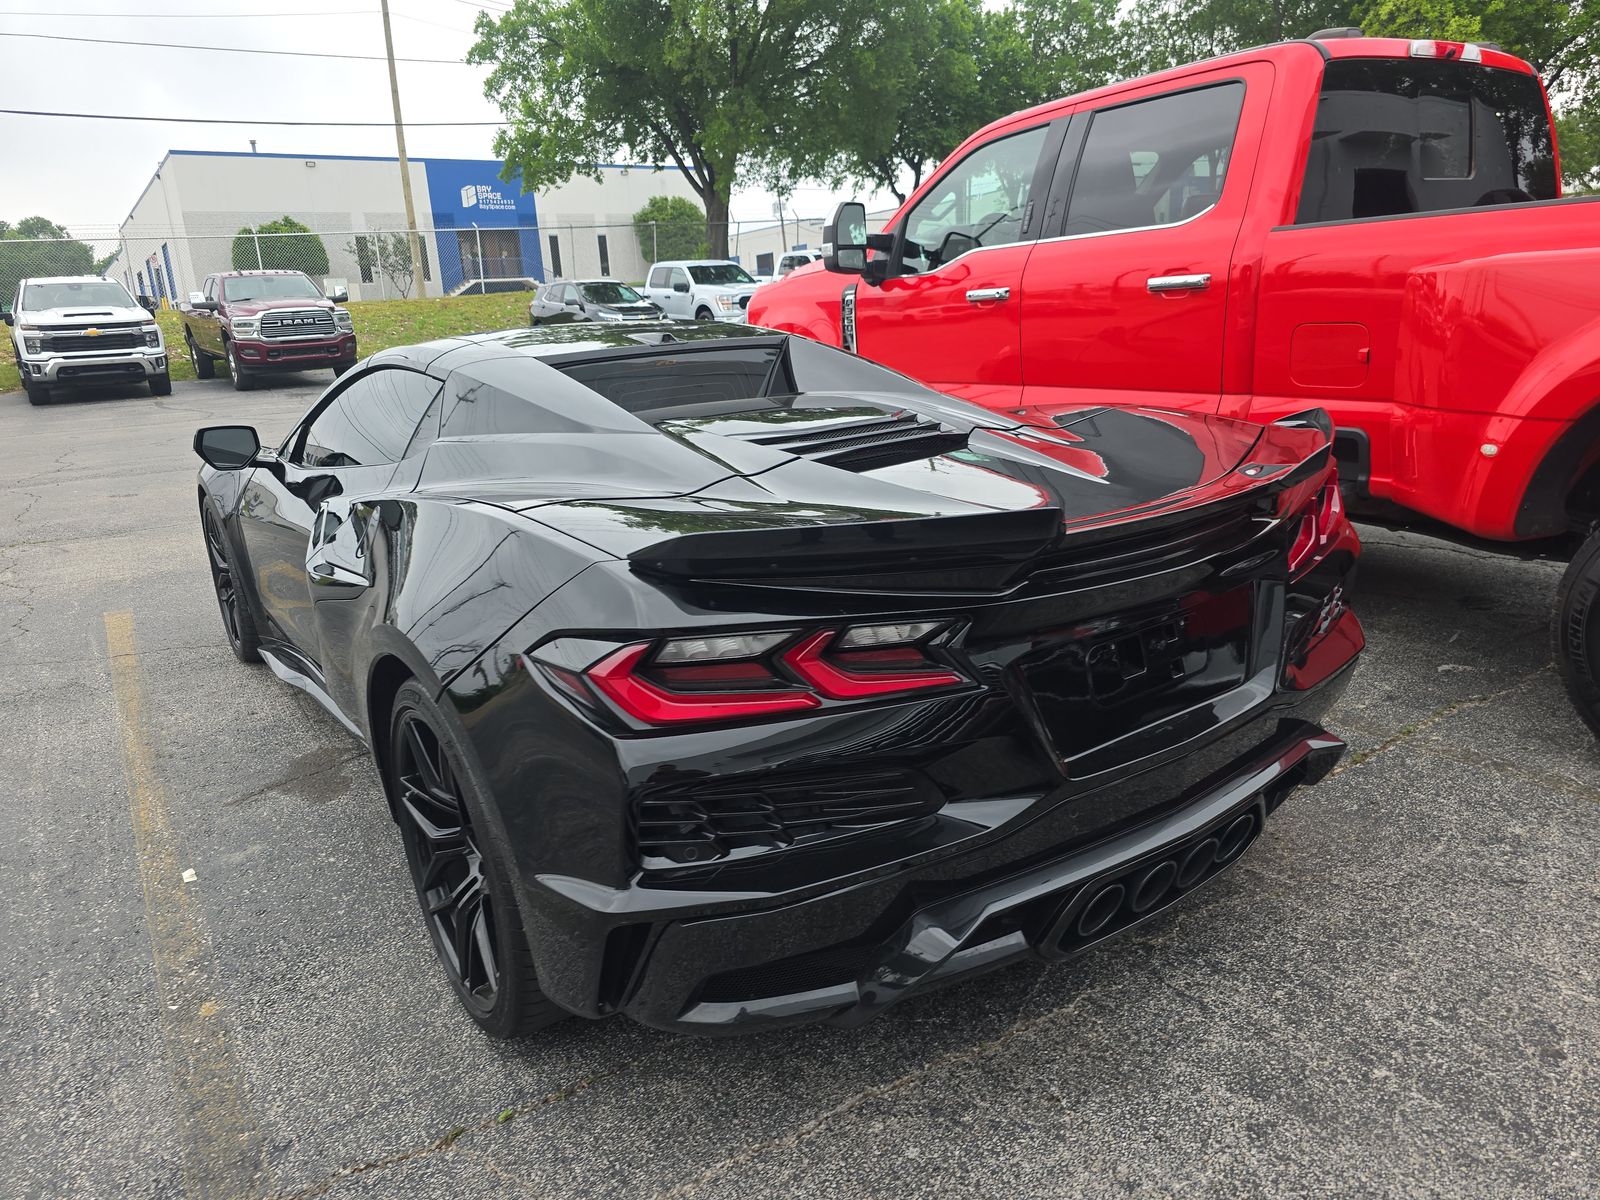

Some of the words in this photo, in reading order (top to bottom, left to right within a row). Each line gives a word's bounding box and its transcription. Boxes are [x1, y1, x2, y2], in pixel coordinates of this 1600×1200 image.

[476, 185, 492, 193] BAY
[477, 192, 502, 200] SPACE
[282, 318, 314, 326] RAM
